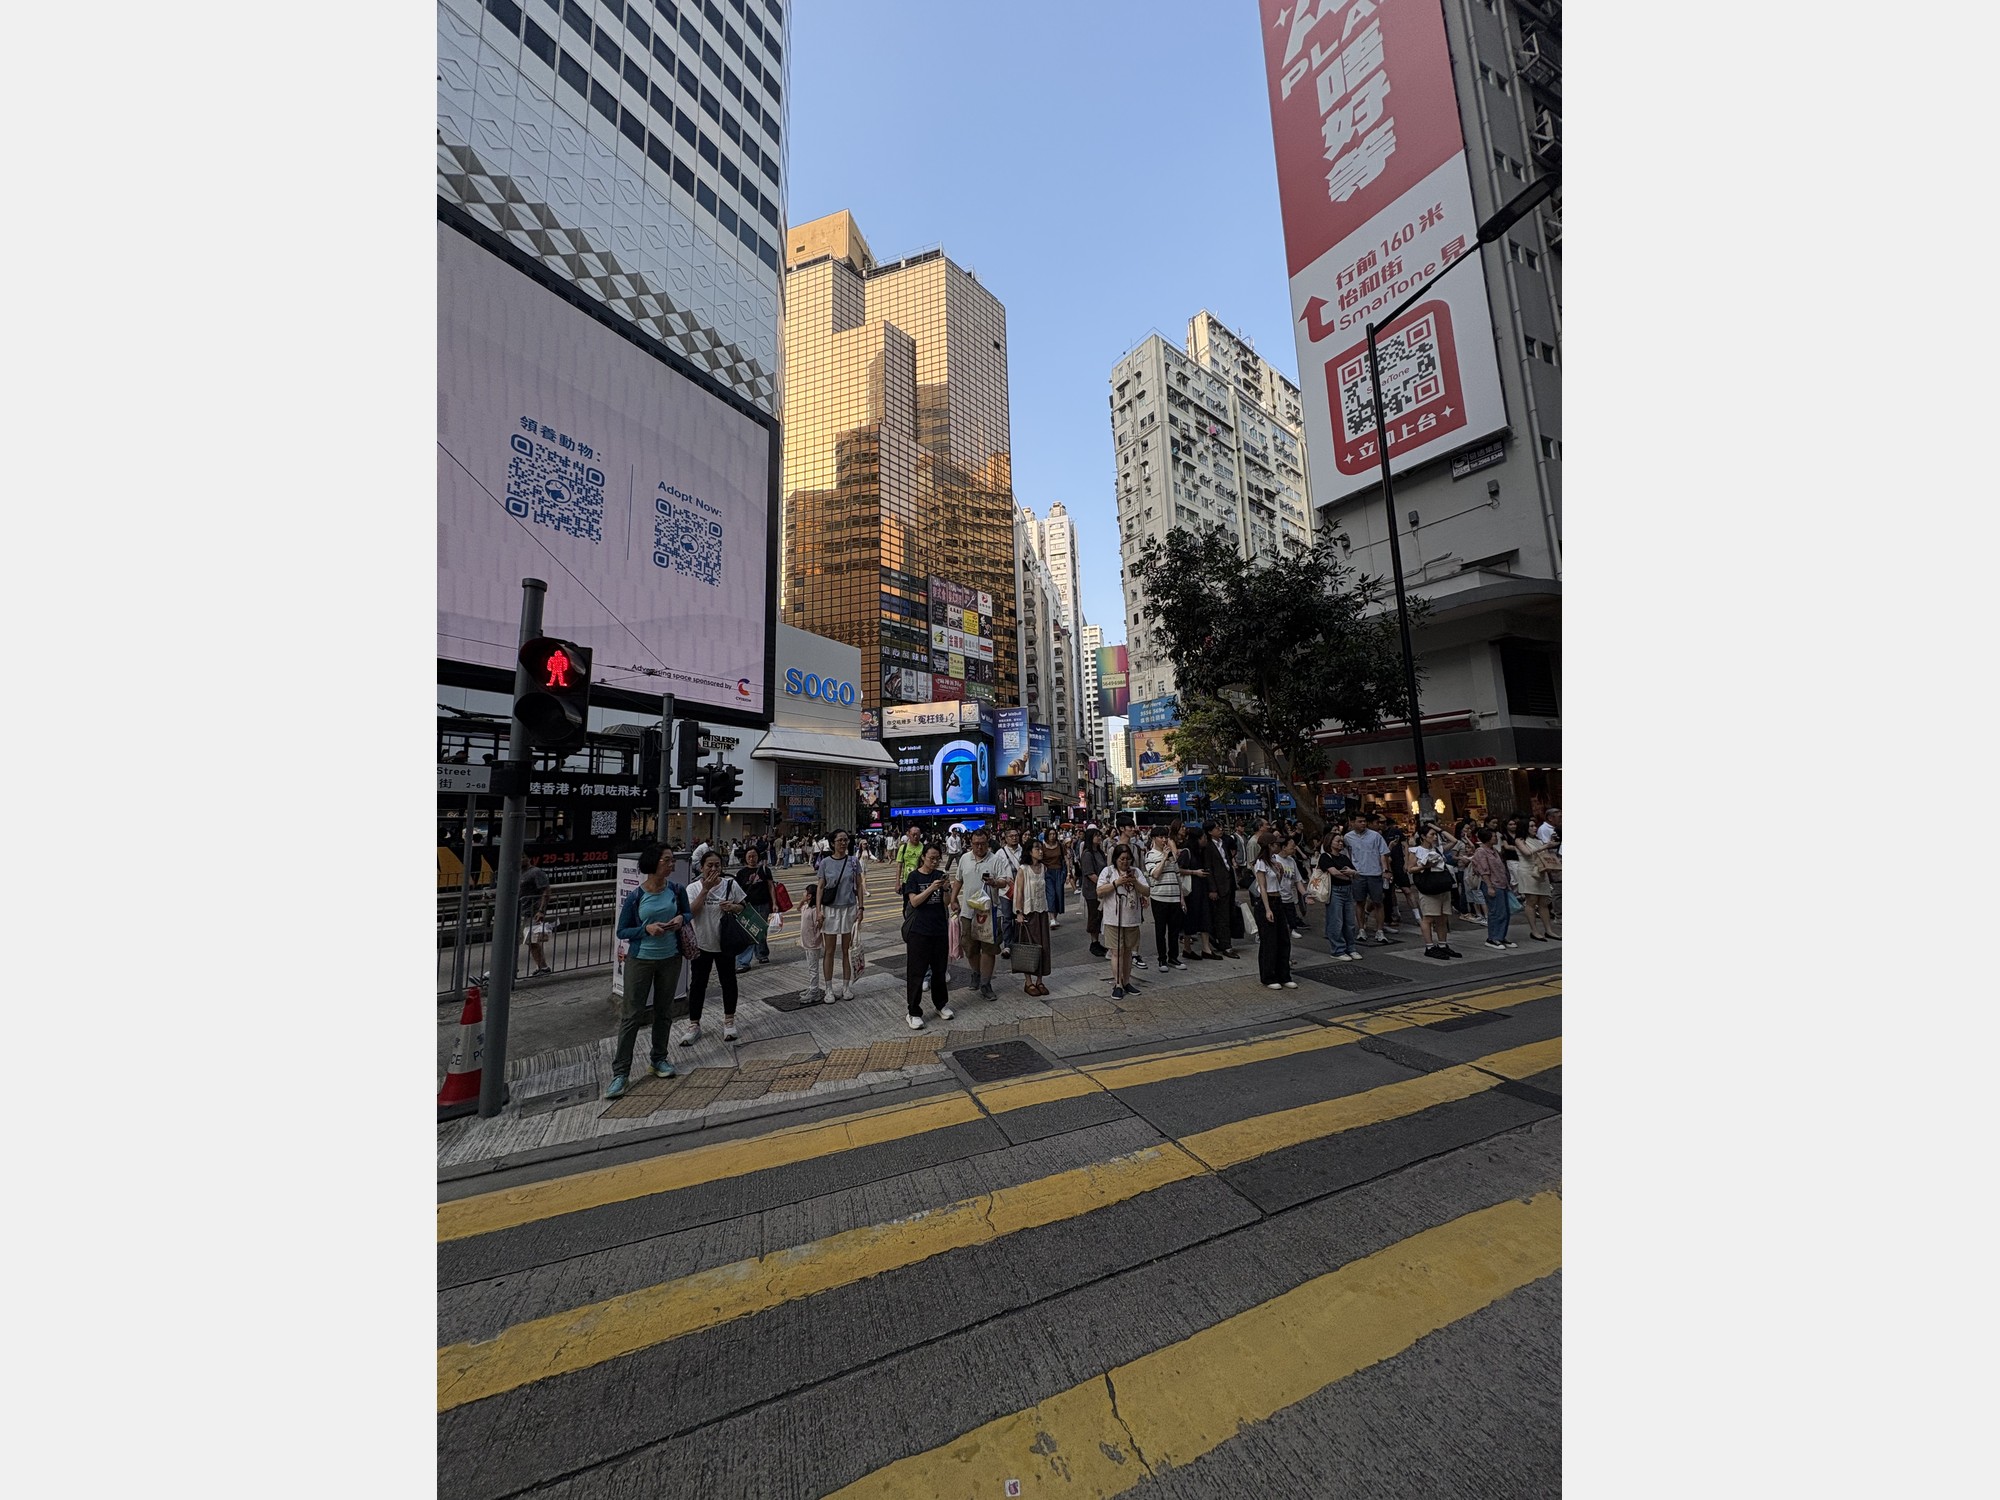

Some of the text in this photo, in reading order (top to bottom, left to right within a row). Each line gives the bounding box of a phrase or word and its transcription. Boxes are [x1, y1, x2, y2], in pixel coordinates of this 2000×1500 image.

[1281, 0, 1385, 101] PLA
[1336, 202, 1445, 290] 行前 160 米
[1338, 255, 1404, 312] 怡和街
[1340, 262, 1437, 331] SmarTone
[1366, 367, 1411, 394] SarTone
[658, 481, 722, 517] Adopt Now:
[632, 664, 732, 690] Adveising space sponsored by
[784, 666, 855, 707] SOGO
[703, 735, 740, 745] MITSUBISHI
[703, 741, 735, 750] ELECTRIC
[437, 766, 472, 776] Street
[439, 778, 453, 789] 街
[542, 852, 580, 864] 29-31,
[582, 850, 609, 863] 2026
